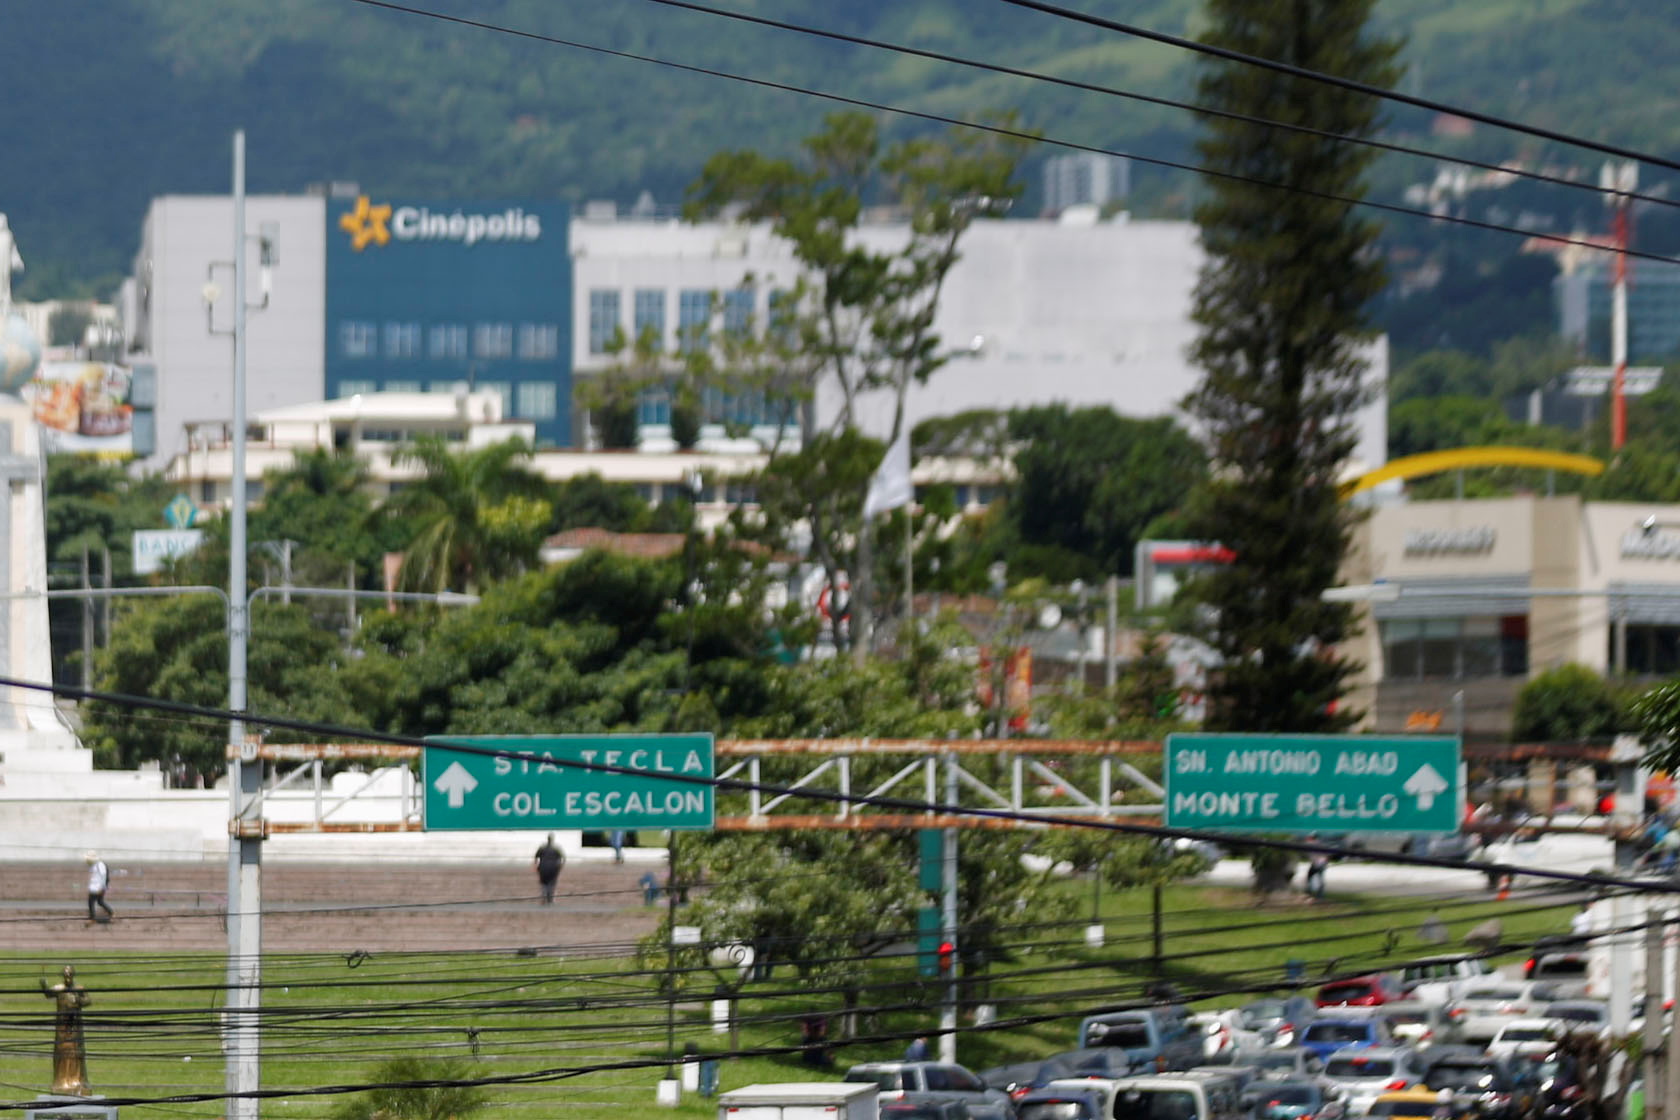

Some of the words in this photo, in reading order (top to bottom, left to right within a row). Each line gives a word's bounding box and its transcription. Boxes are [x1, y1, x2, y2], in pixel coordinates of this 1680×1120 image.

[393, 206, 540, 246] Cinépolis
[494, 750, 563, 775] STA.
[580, 750, 704, 774] TECLA
[1175, 750, 1213, 774] SN.
[1224, 750, 1322, 775] ANTONIO
[1334, 750, 1399, 776] ABAD
[493, 792, 557, 816] COL.
[565, 790, 705, 815] ESCALON
[1173, 791, 1280, 818] MONTE
[1294, 793, 1399, 818] BELLO
